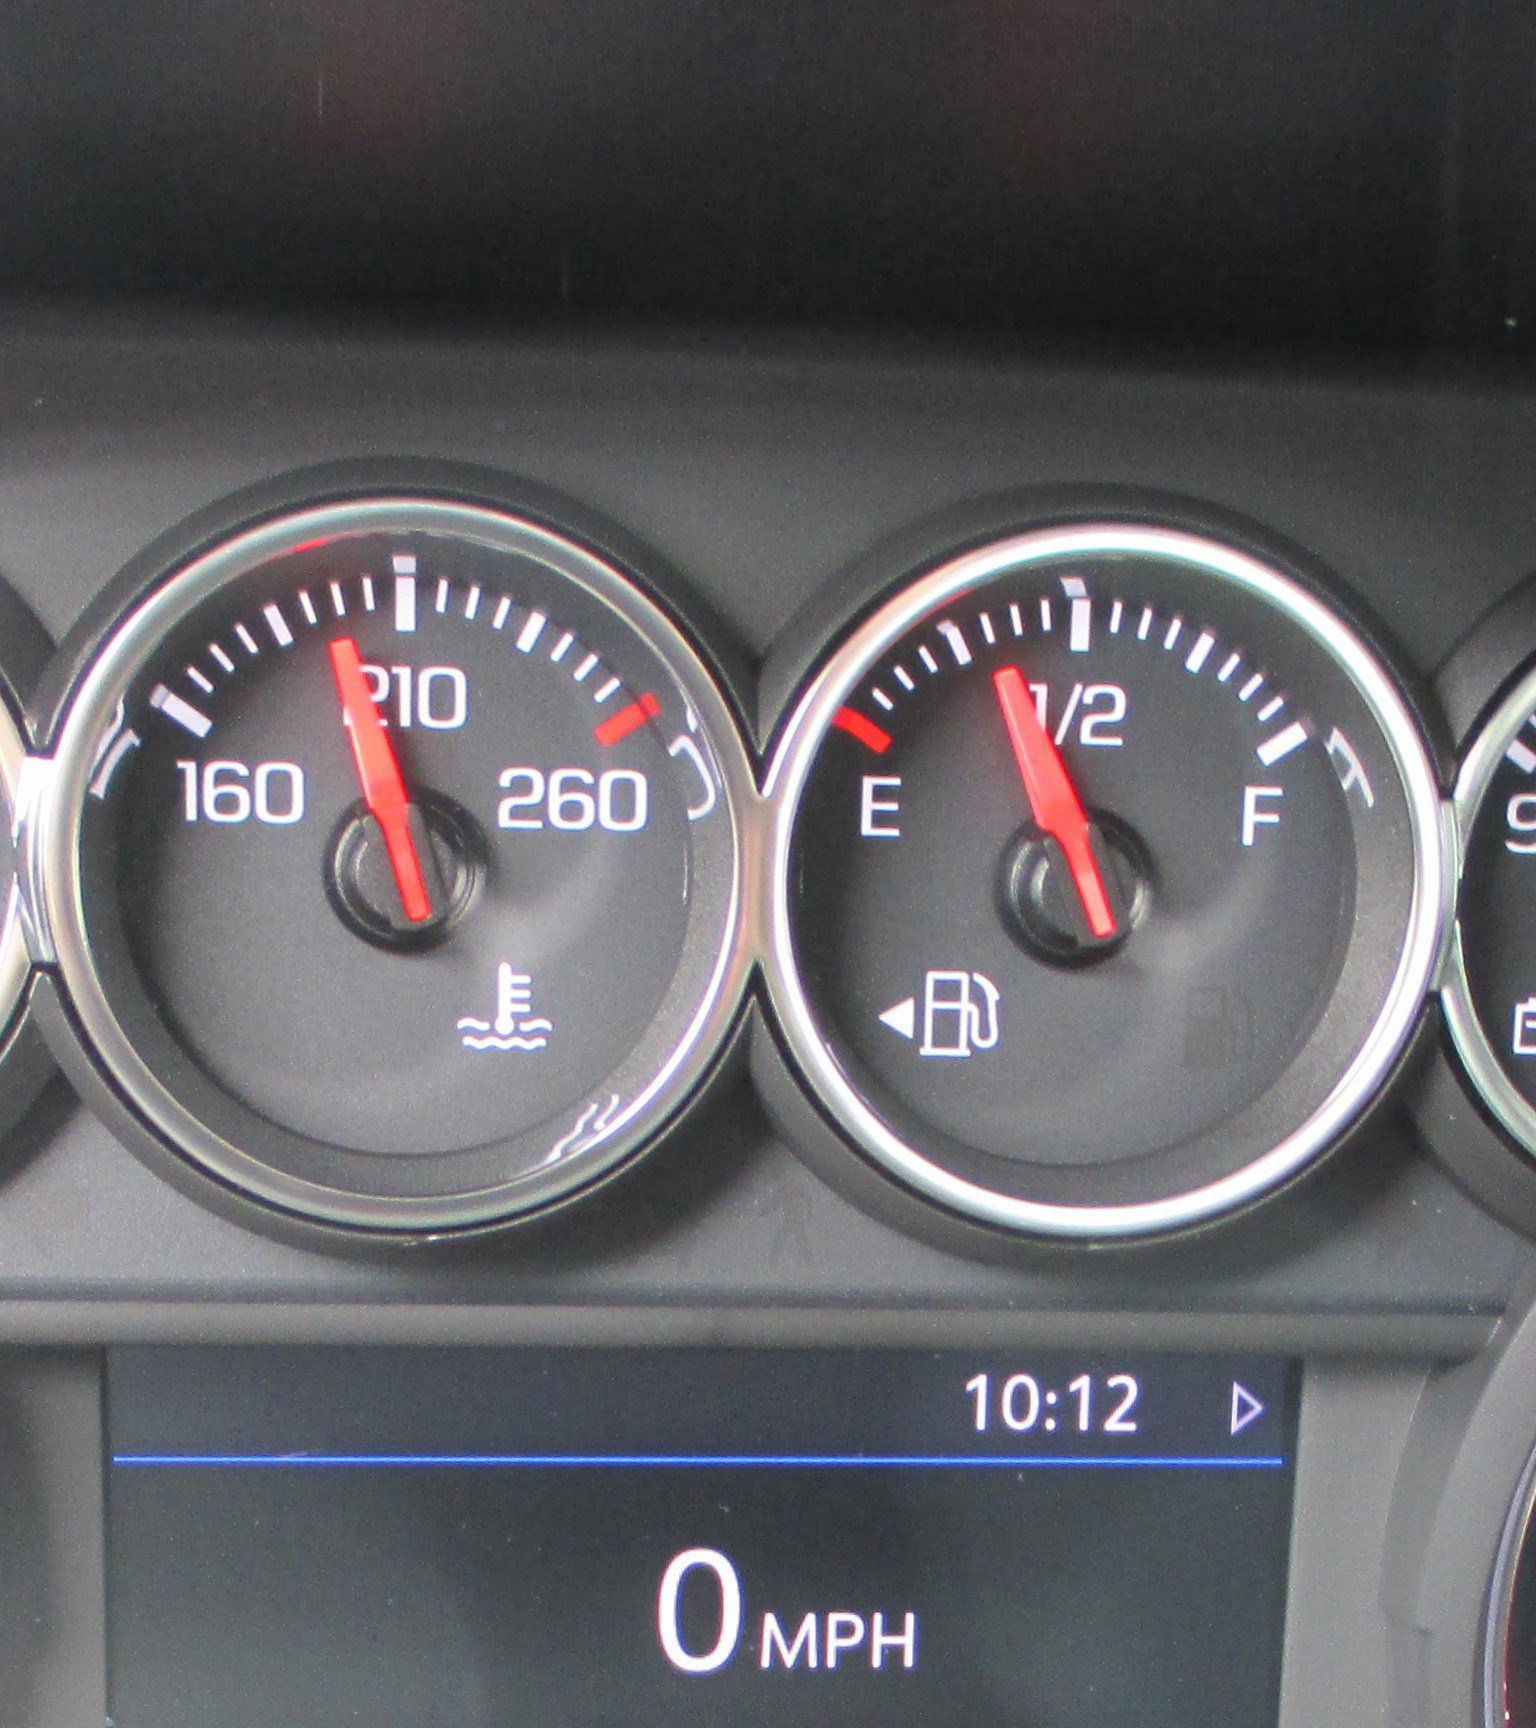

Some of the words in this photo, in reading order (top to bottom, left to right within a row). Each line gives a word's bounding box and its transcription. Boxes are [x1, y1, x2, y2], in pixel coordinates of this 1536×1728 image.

[178, 760, 305, 825] 160
[498, 767, 647, 833] 260
[861, 776, 901, 838] E
[1242, 786, 1283, 846] F
[966, 1374, 1139, 1433] 10:12
[658, 1548, 743, 1674] 0
[760, 1612, 916, 1669] MPH
